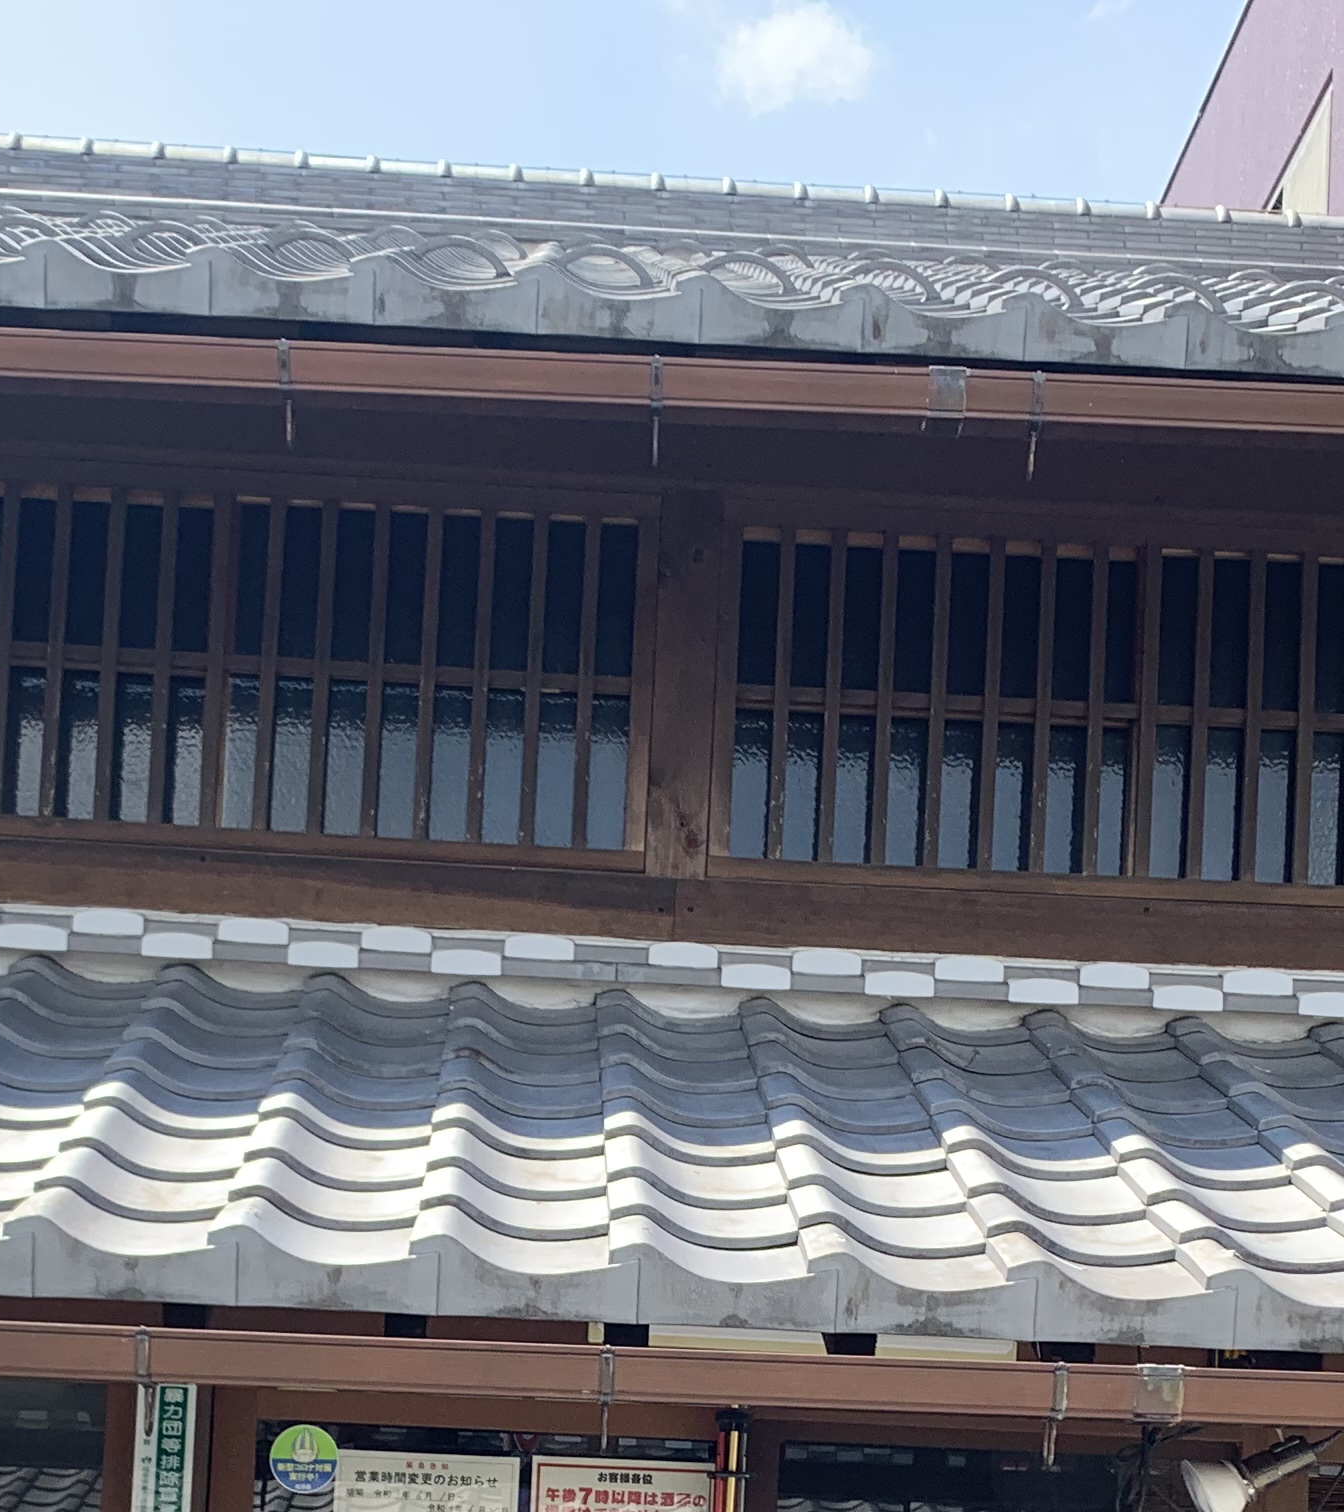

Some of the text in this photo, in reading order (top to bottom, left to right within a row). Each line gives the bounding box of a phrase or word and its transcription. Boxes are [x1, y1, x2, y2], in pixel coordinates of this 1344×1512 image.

[354, 1469, 499, 1489] 営業時間変更のお知らせ
[597, 1471, 654, 1486] お客様各位
